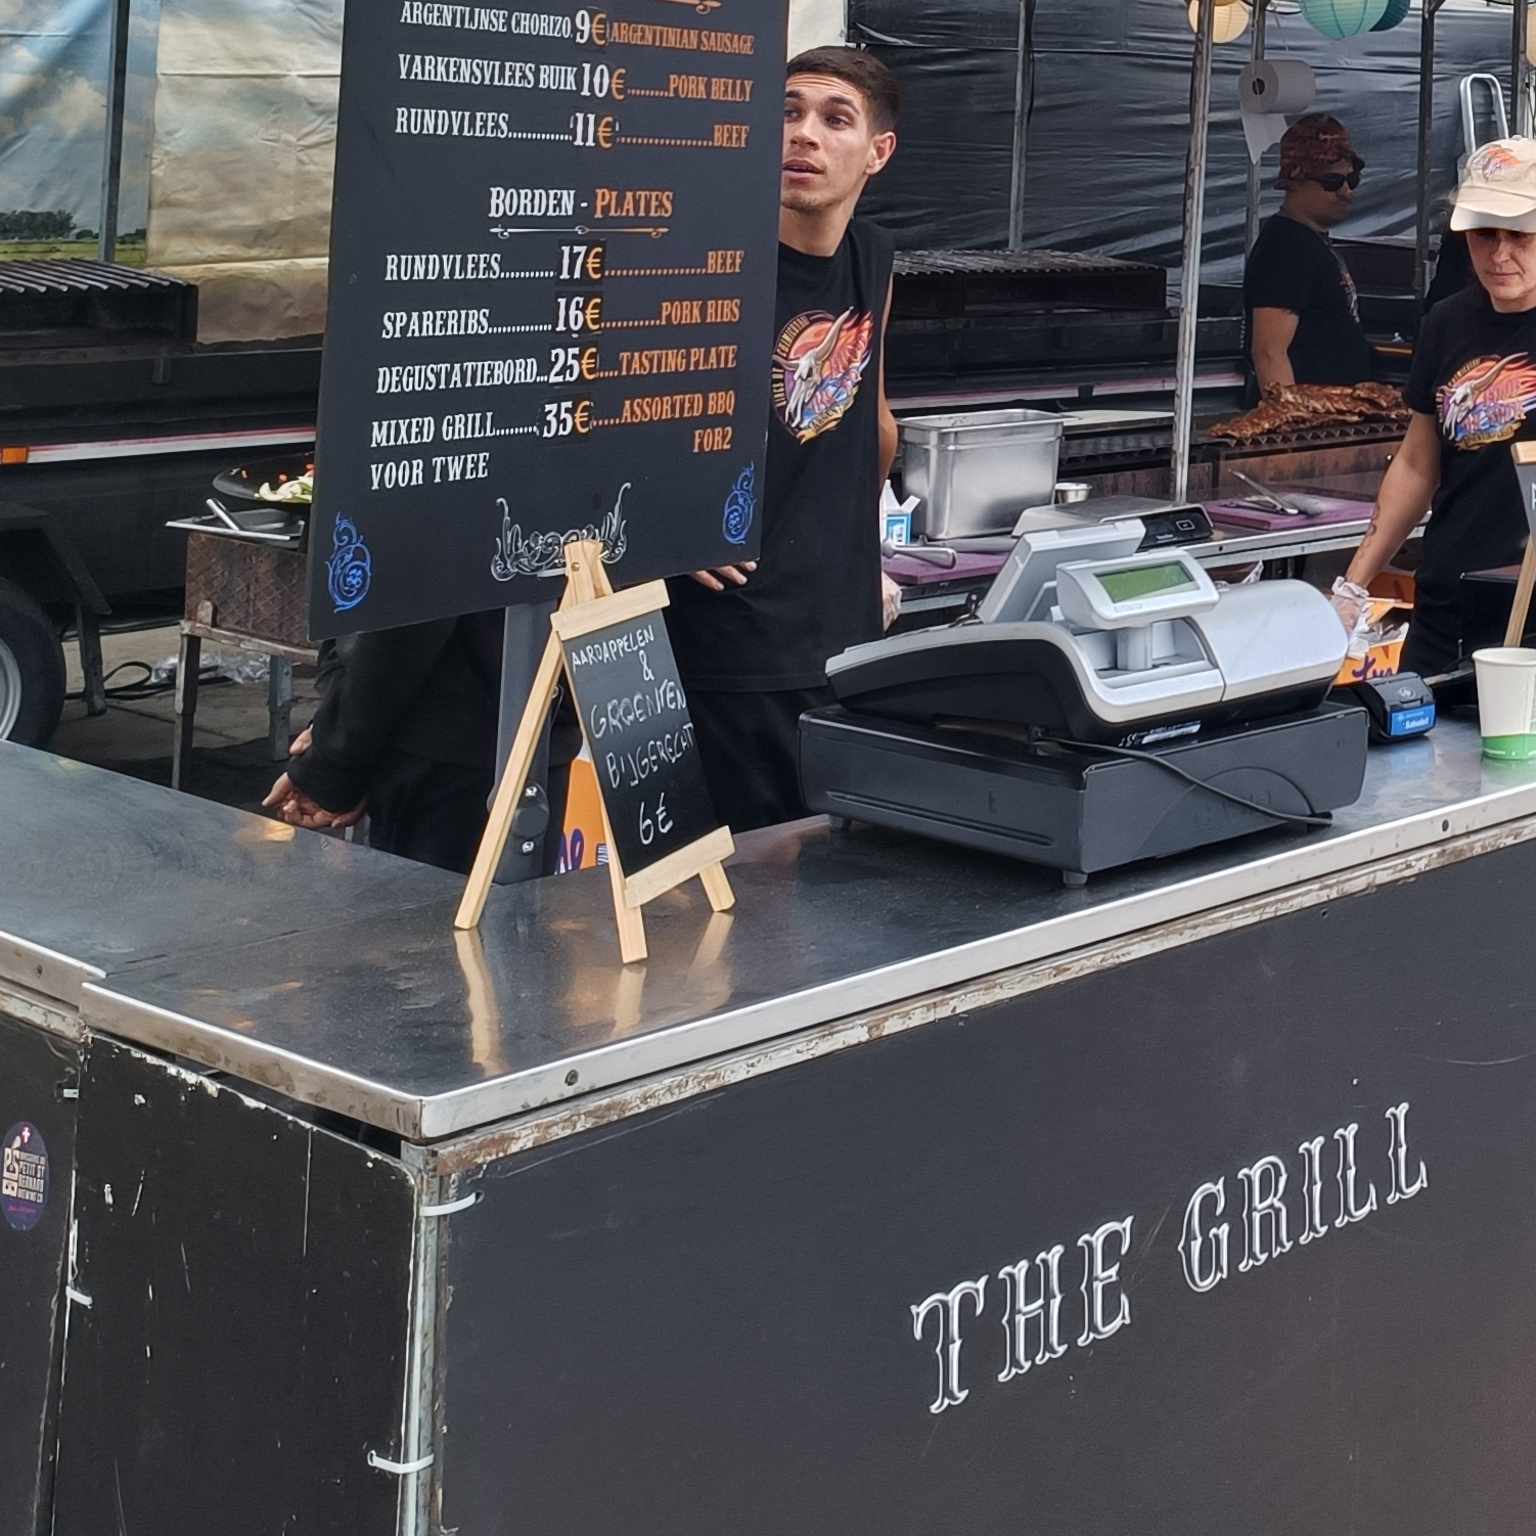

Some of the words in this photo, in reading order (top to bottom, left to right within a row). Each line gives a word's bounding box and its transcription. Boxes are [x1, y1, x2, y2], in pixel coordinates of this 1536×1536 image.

[400, 1, 508, 34] ARGENTIJNSE
[610, 21, 698, 51] ARGENTINIAN
[700, 30, 754, 55] SAUSAGE
[399, 52, 536, 89] VARKENSVLEES
[539, 64, 577, 92] BUIK
[710, 77, 754, 103] BELLY
[488, 187, 574, 218] BORDEN
[594, 188, 674, 218] PLATES
[706, 298, 741, 324] RIBS
[689, 345, 738, 371] PLATE
[370, 416, 435, 448] MIXED
[706, 390, 736, 417] BBQ
[370, 457, 424, 491] VOOR
[432, 452, 489, 484] TWEE
[911, 1215, 1135, 1413] THE
[1177, 1101, 1429, 1293] GRILL
